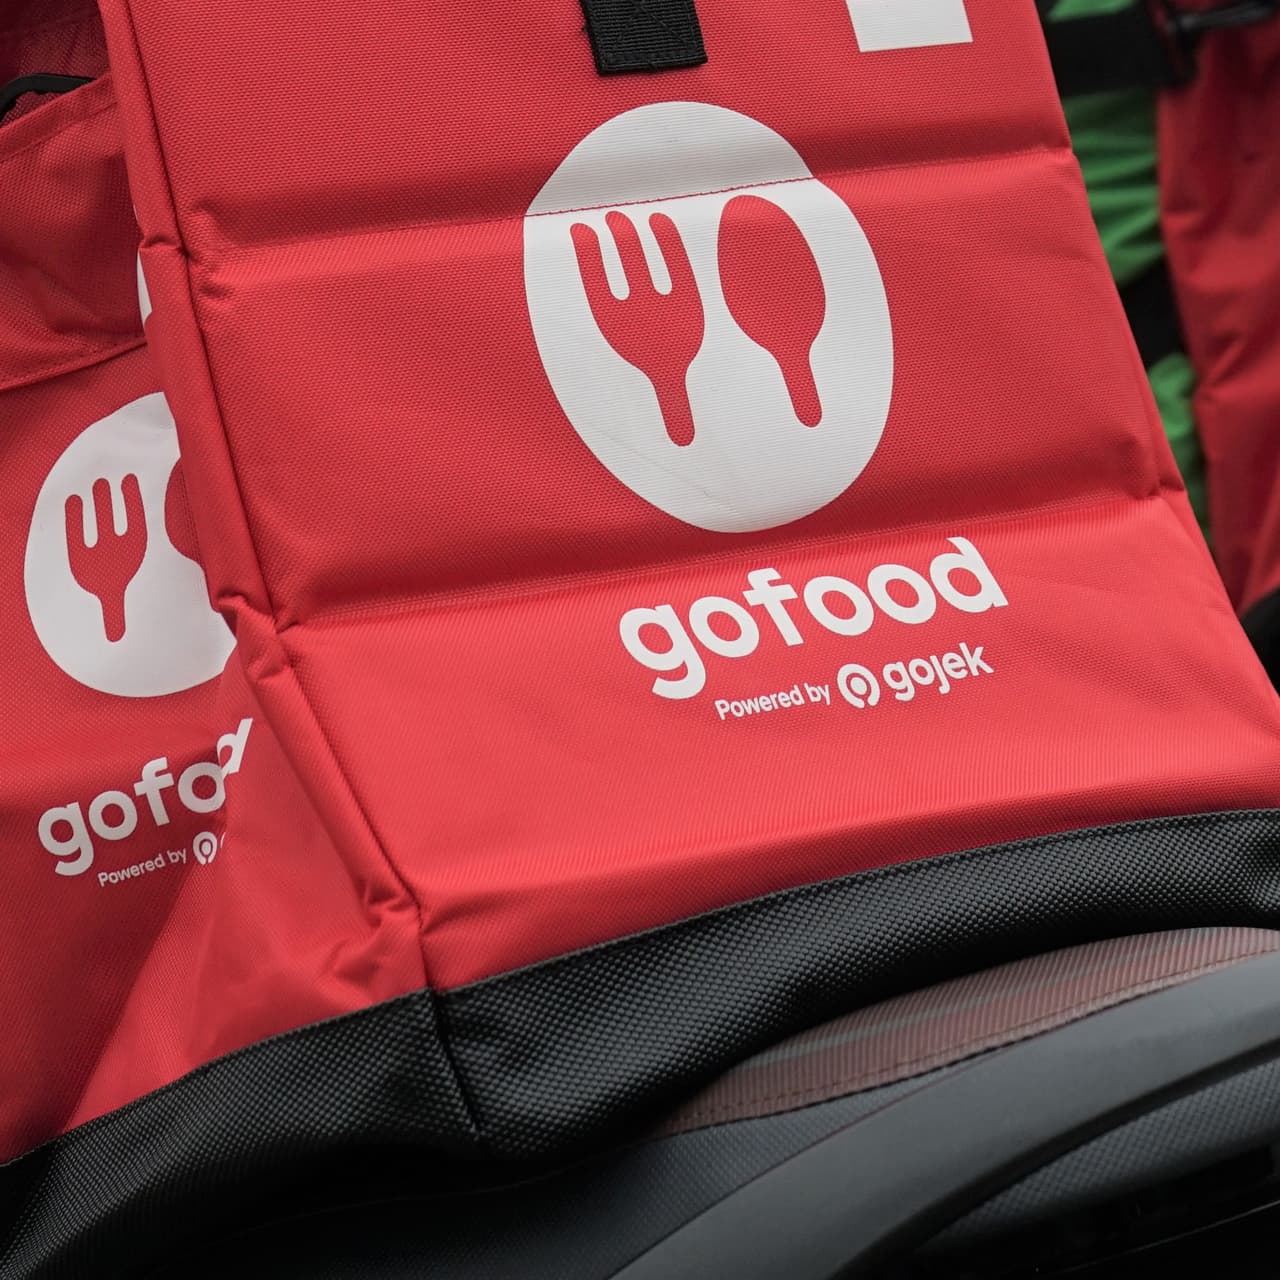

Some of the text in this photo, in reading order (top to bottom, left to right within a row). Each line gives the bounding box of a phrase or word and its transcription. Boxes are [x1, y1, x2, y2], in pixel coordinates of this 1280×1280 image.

[619, 537, 1009, 699] gofood
[714, 642, 994, 720] Powered by gojek
[97, 848, 187, 887] Powered by
